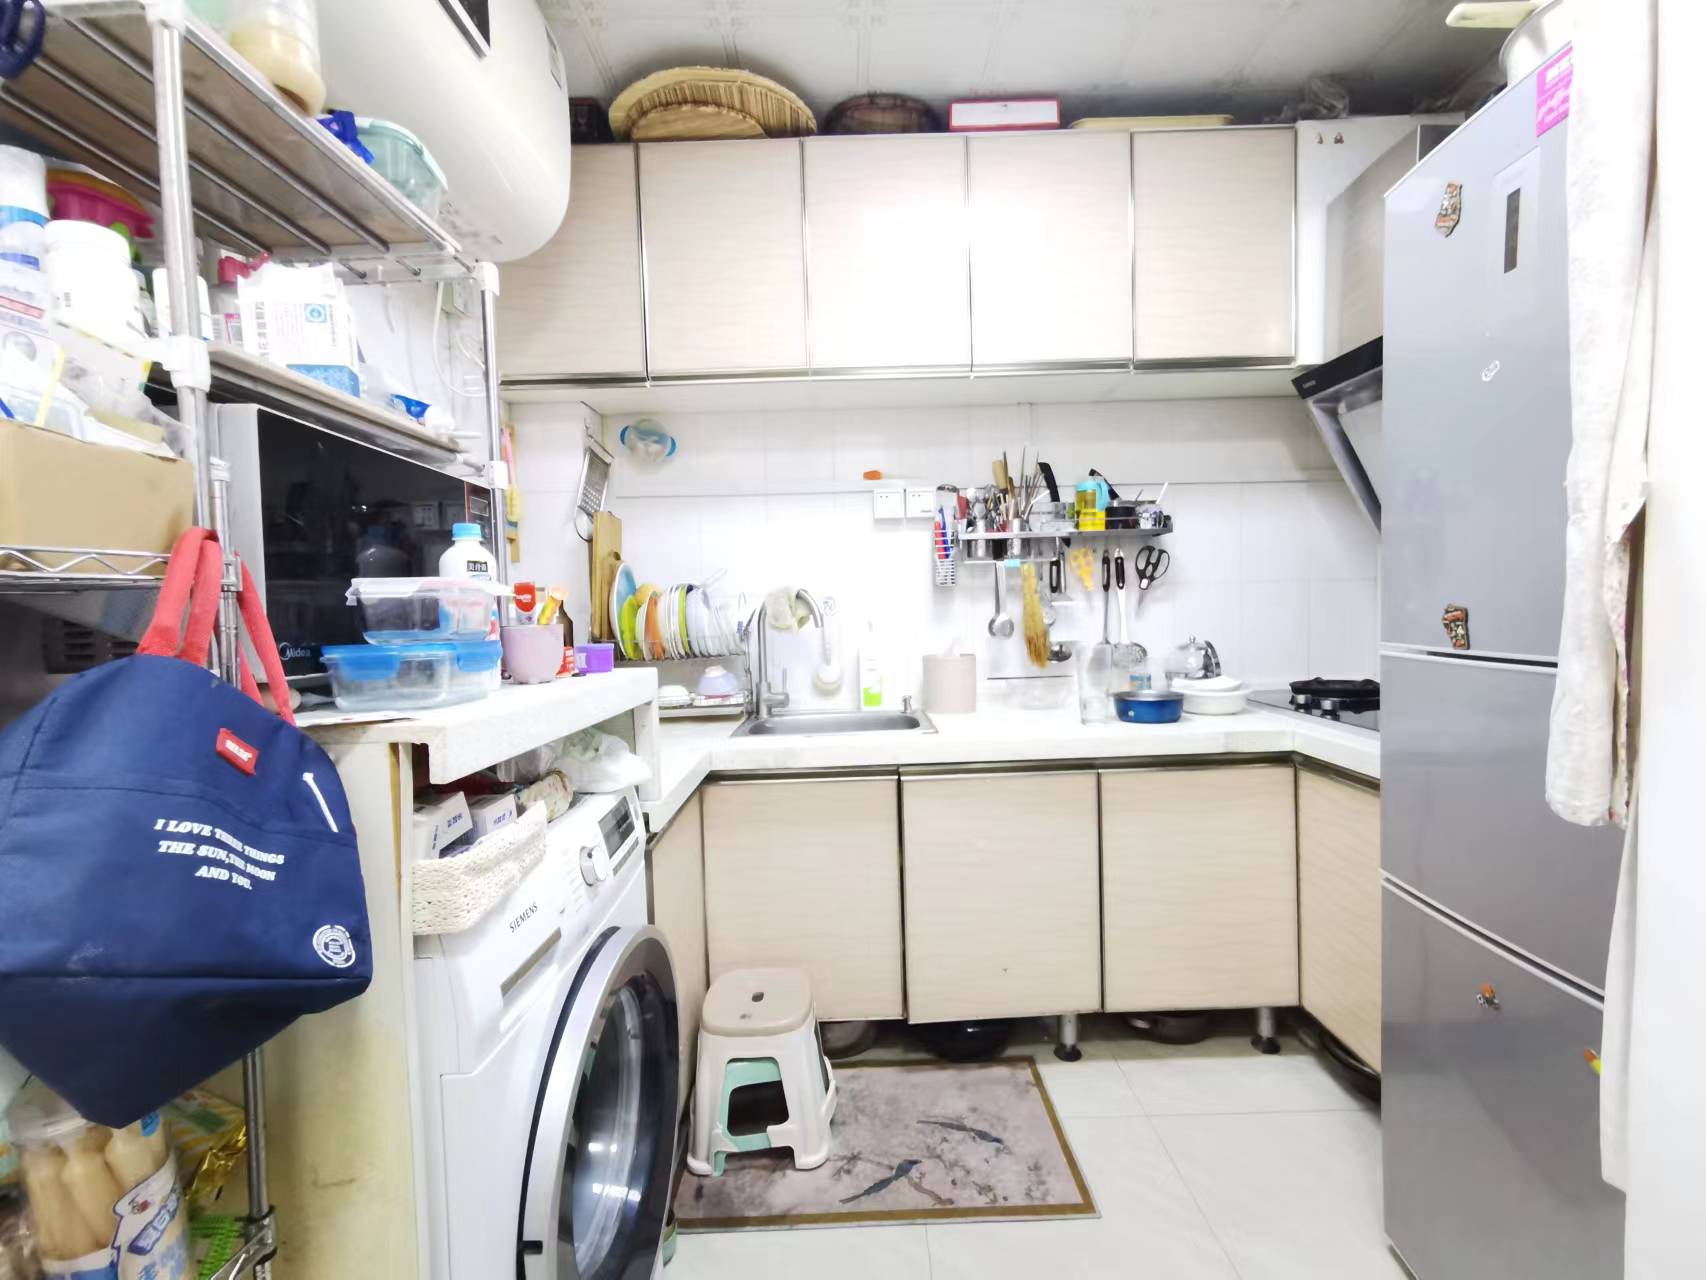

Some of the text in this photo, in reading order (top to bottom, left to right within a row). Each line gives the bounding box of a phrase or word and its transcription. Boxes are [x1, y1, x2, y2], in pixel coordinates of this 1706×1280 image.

[283, 645, 311, 658] Midea
[154, 818, 166, 830] I
[166, 820, 213, 837] LOVE
[243, 845, 285, 865] THINGS
[158, 840, 196, 855] THE
[195, 865, 230, 881] AND
[509, 901, 538, 933] SIEMENS
